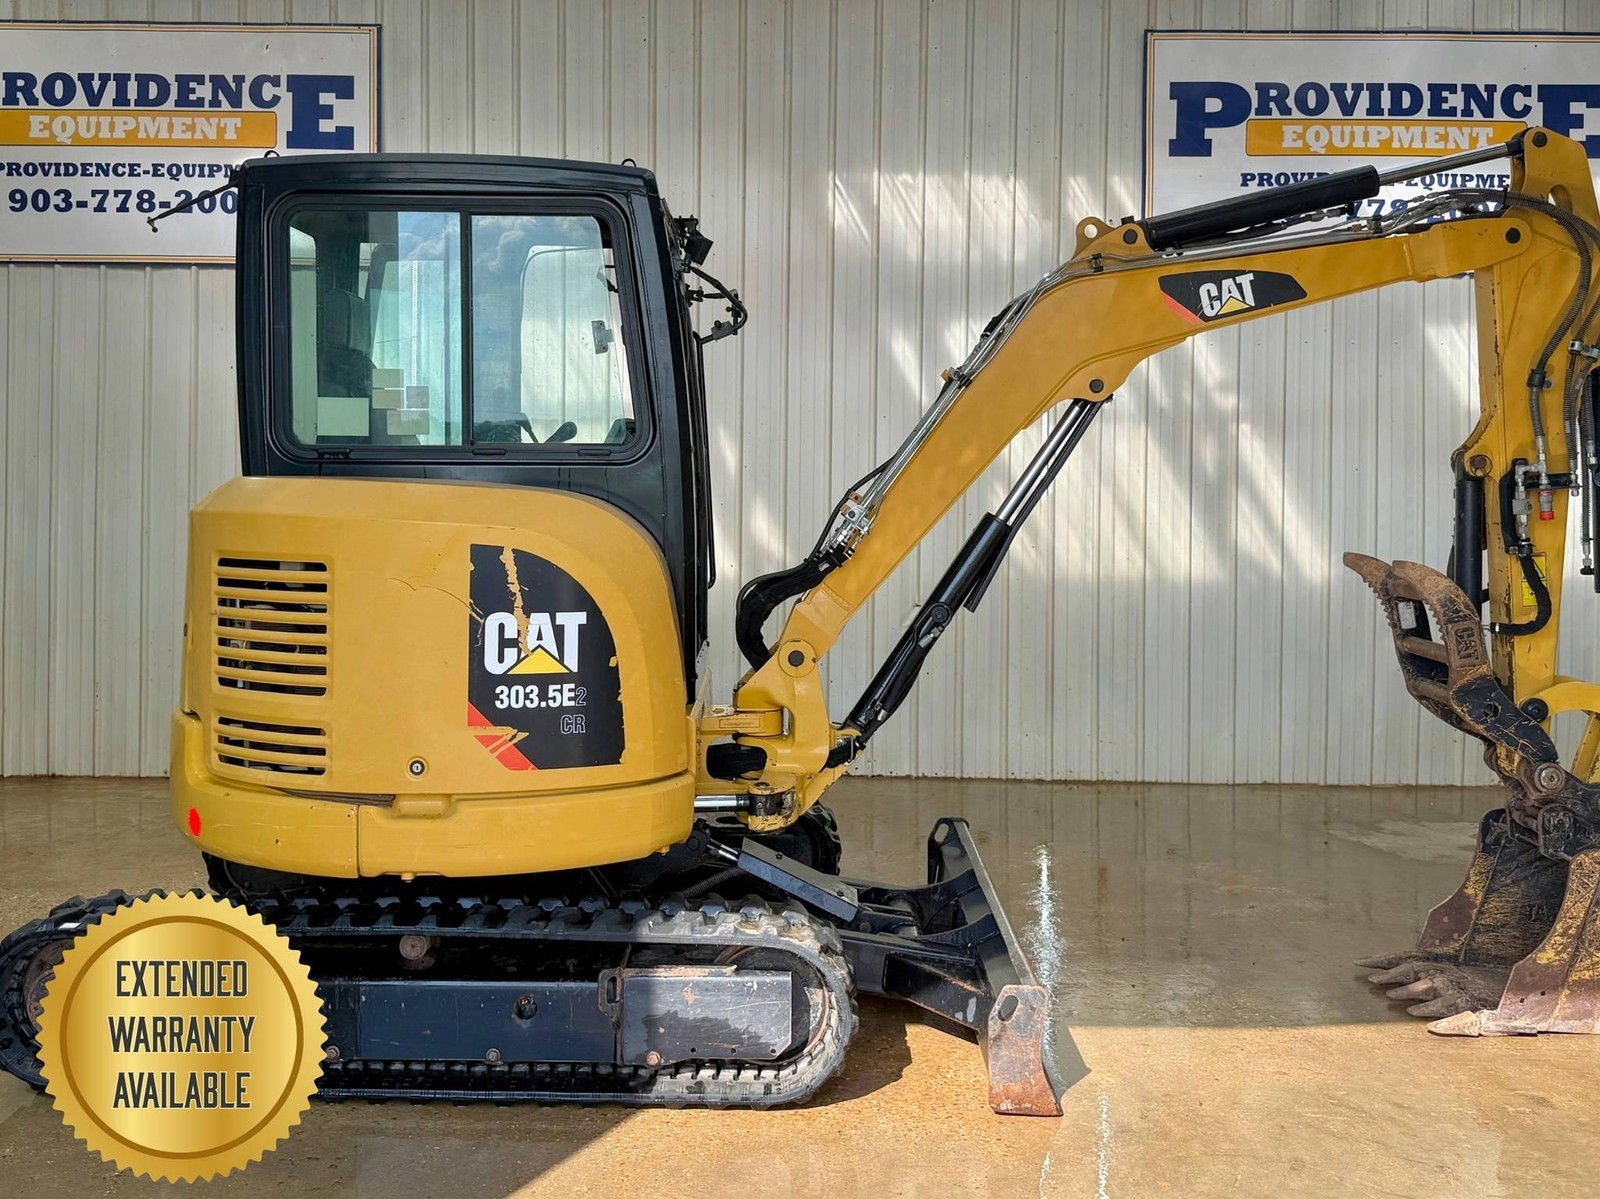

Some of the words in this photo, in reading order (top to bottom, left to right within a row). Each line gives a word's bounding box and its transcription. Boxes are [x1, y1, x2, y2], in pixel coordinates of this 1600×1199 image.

[29, 115, 241, 144] EQUIPMENT
[1168, 82, 1600, 157] PROVIDENCE
[1281, 125, 1494, 153] EQUIPMENT
[1199, 273, 1256, 317] CAT
[484, 611, 587, 674] CAT
[495, 684, 586, 708] 303.5E2
[560, 714, 586, 735] CR
